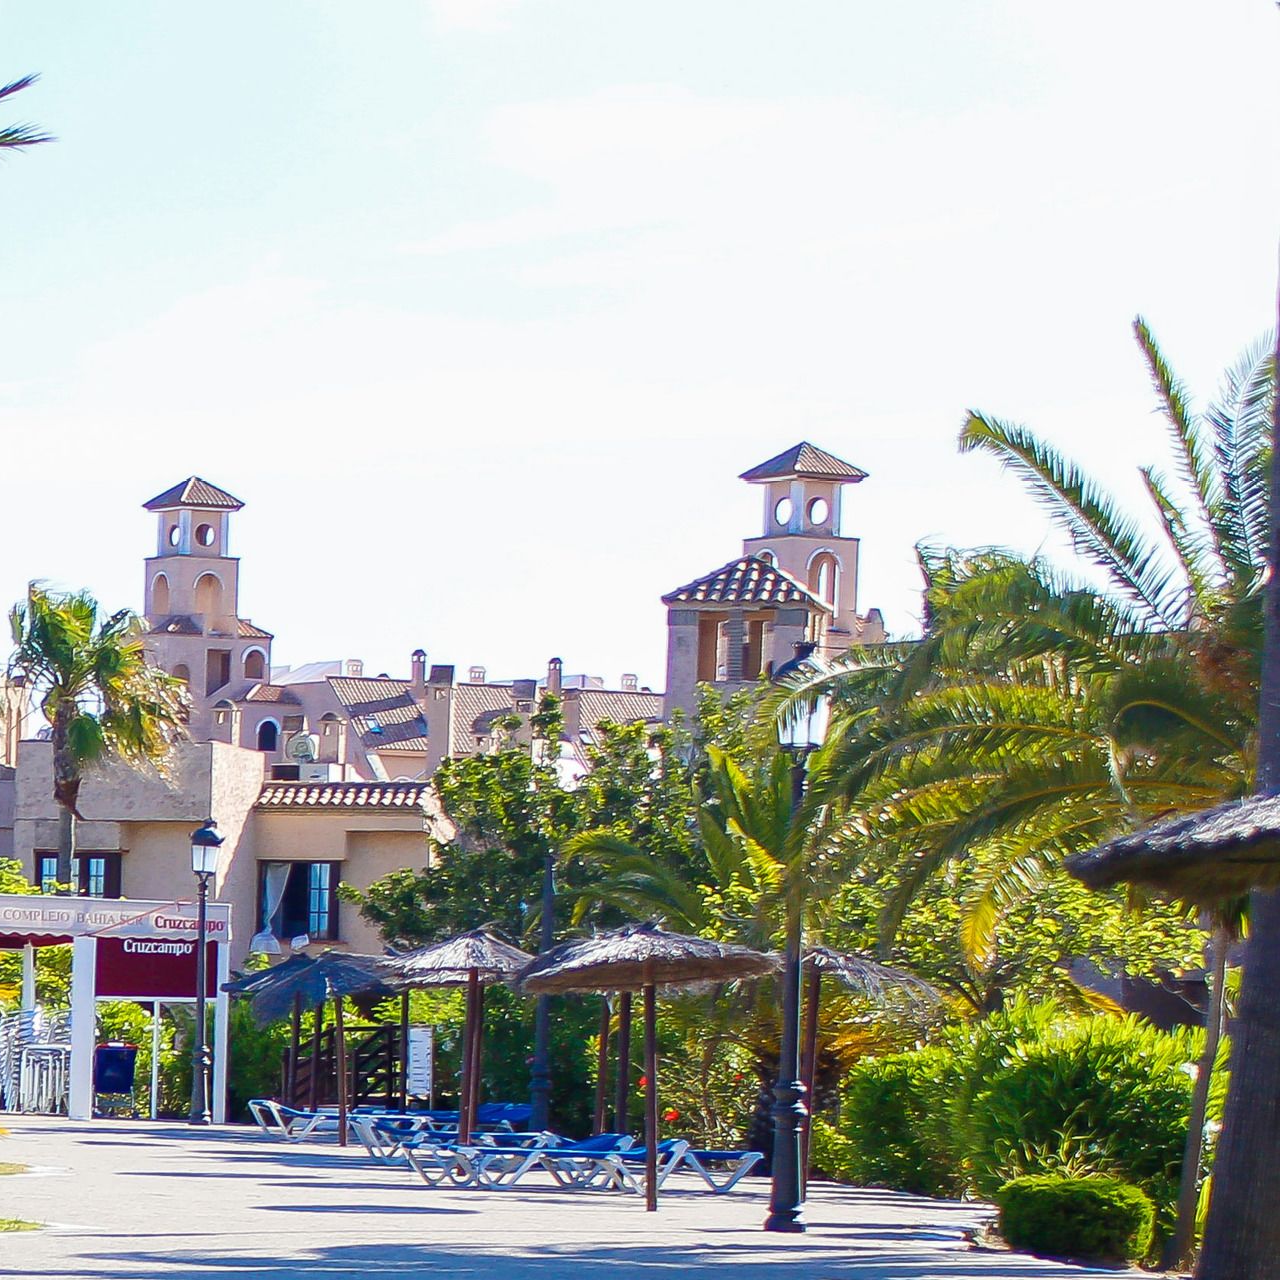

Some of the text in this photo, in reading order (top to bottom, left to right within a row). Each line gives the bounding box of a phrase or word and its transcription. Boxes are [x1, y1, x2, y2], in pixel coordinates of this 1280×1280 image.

[3, 908, 70, 922] COMPLEJO
[154, 915, 225, 933] Cruzcapo
[123, 939, 193, 956] Cruzcampo
